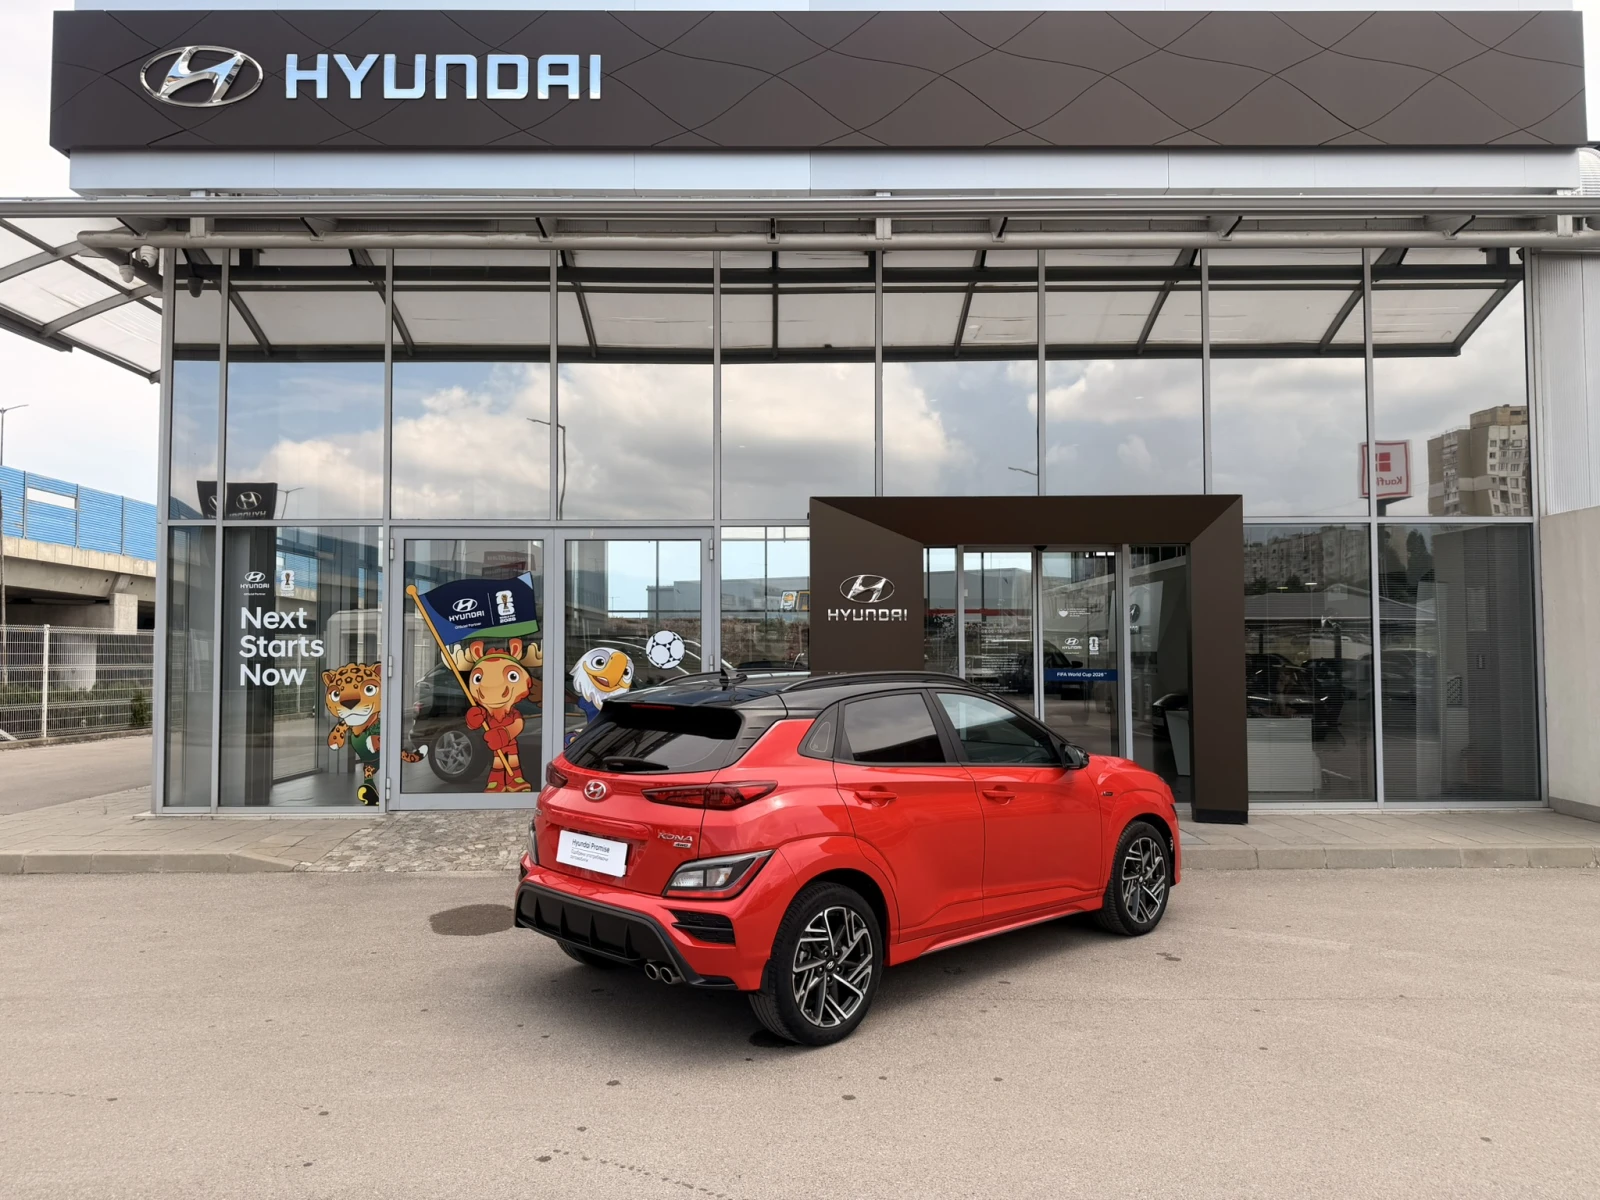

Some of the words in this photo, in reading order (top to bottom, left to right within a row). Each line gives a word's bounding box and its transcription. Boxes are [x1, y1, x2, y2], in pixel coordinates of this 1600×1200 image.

[285, 54, 602, 100] HYUNDAI
[240, 606, 308, 629] Next
[448, 610, 485, 622] HYUNDAI
[827, 608, 908, 621] HYUNDAI
[239, 634, 325, 658] Starts
[240, 663, 308, 686] Now
[571, 838, 590, 849] Hyundai
[590, 842, 610, 853] Promise
[657, 831, 693, 842] KONA
